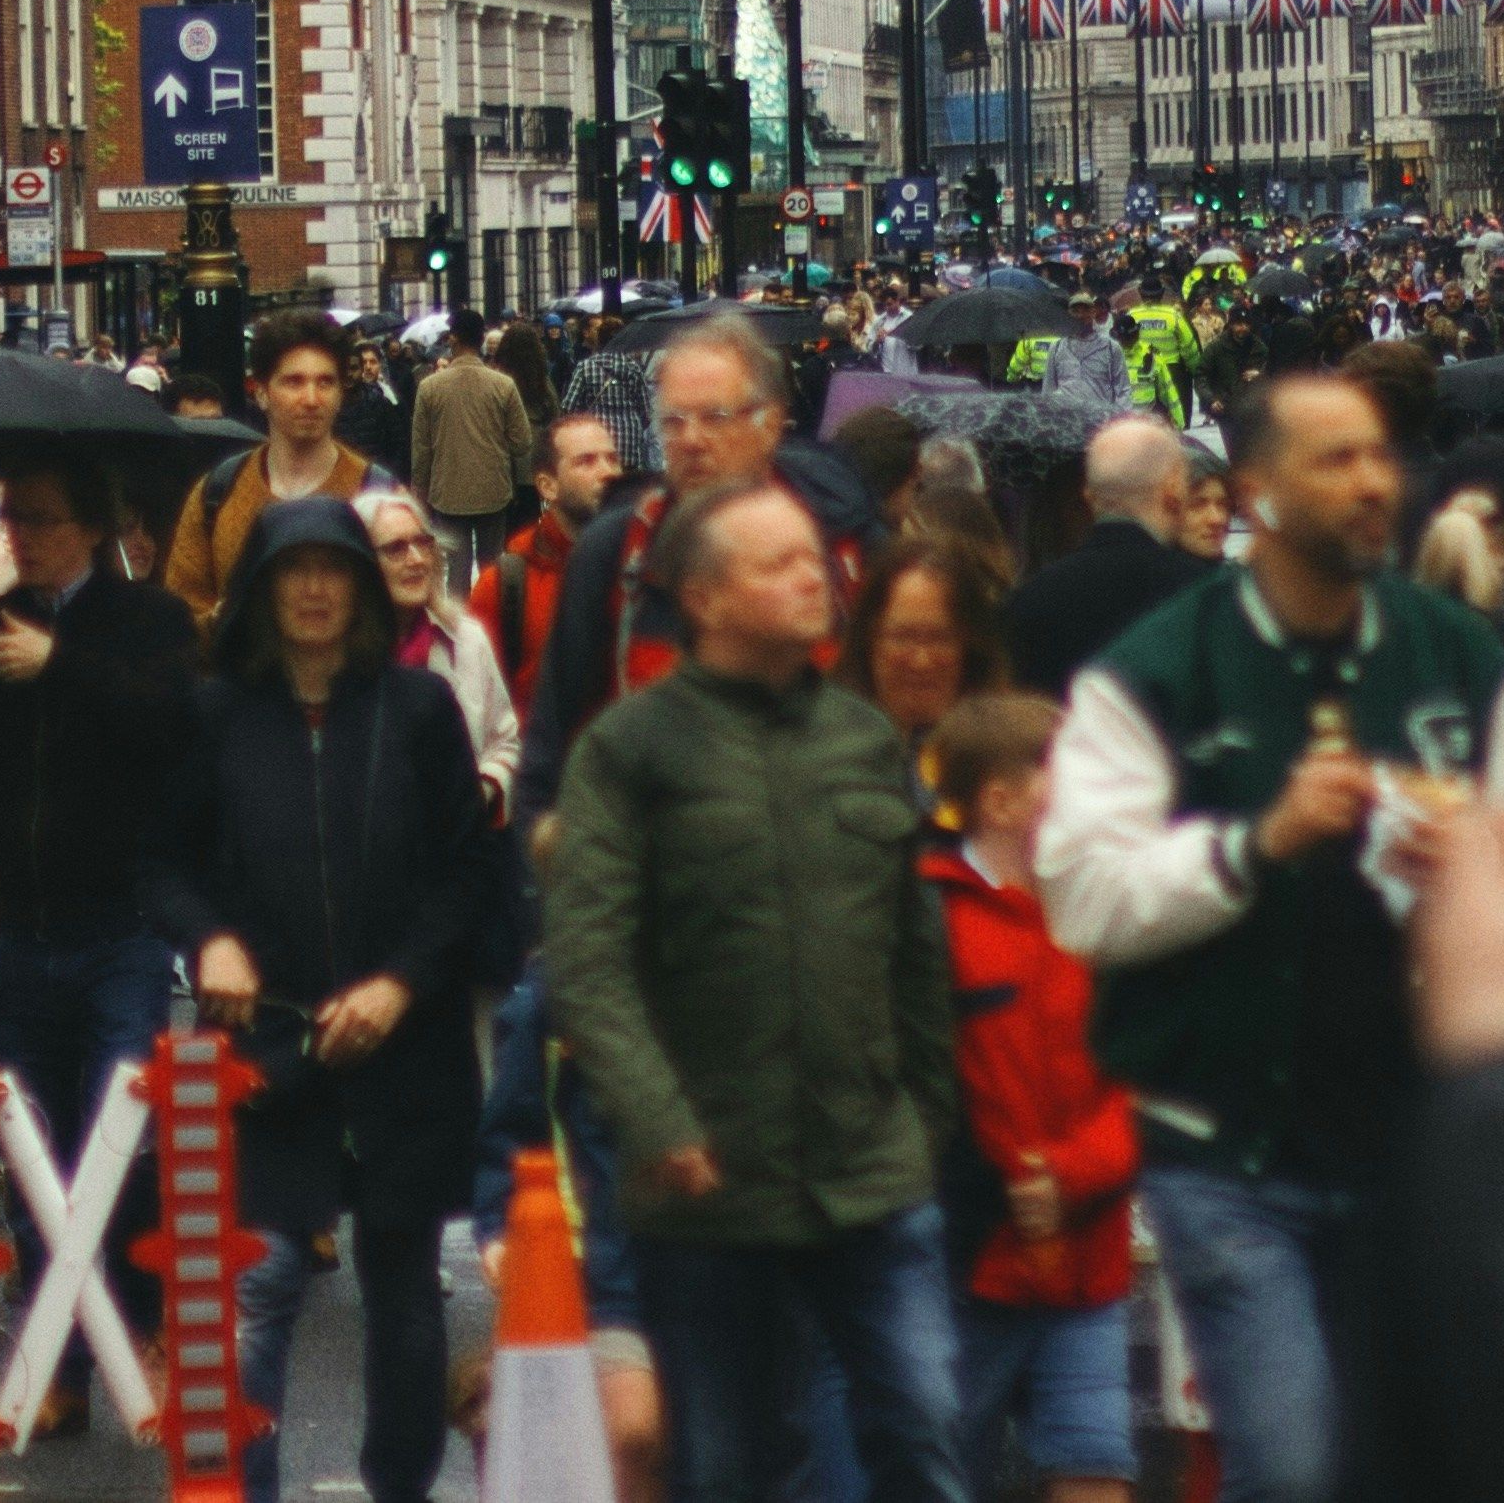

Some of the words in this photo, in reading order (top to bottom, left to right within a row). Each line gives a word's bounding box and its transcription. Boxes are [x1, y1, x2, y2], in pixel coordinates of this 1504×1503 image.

[173, 132, 228, 147] SCREEN
[49, 147, 61, 166] S
[186, 148, 216, 161] SITE
[786, 197, 810, 212] 20
[601, 266, 617, 279] 80
[195, 290, 219, 307] 81
